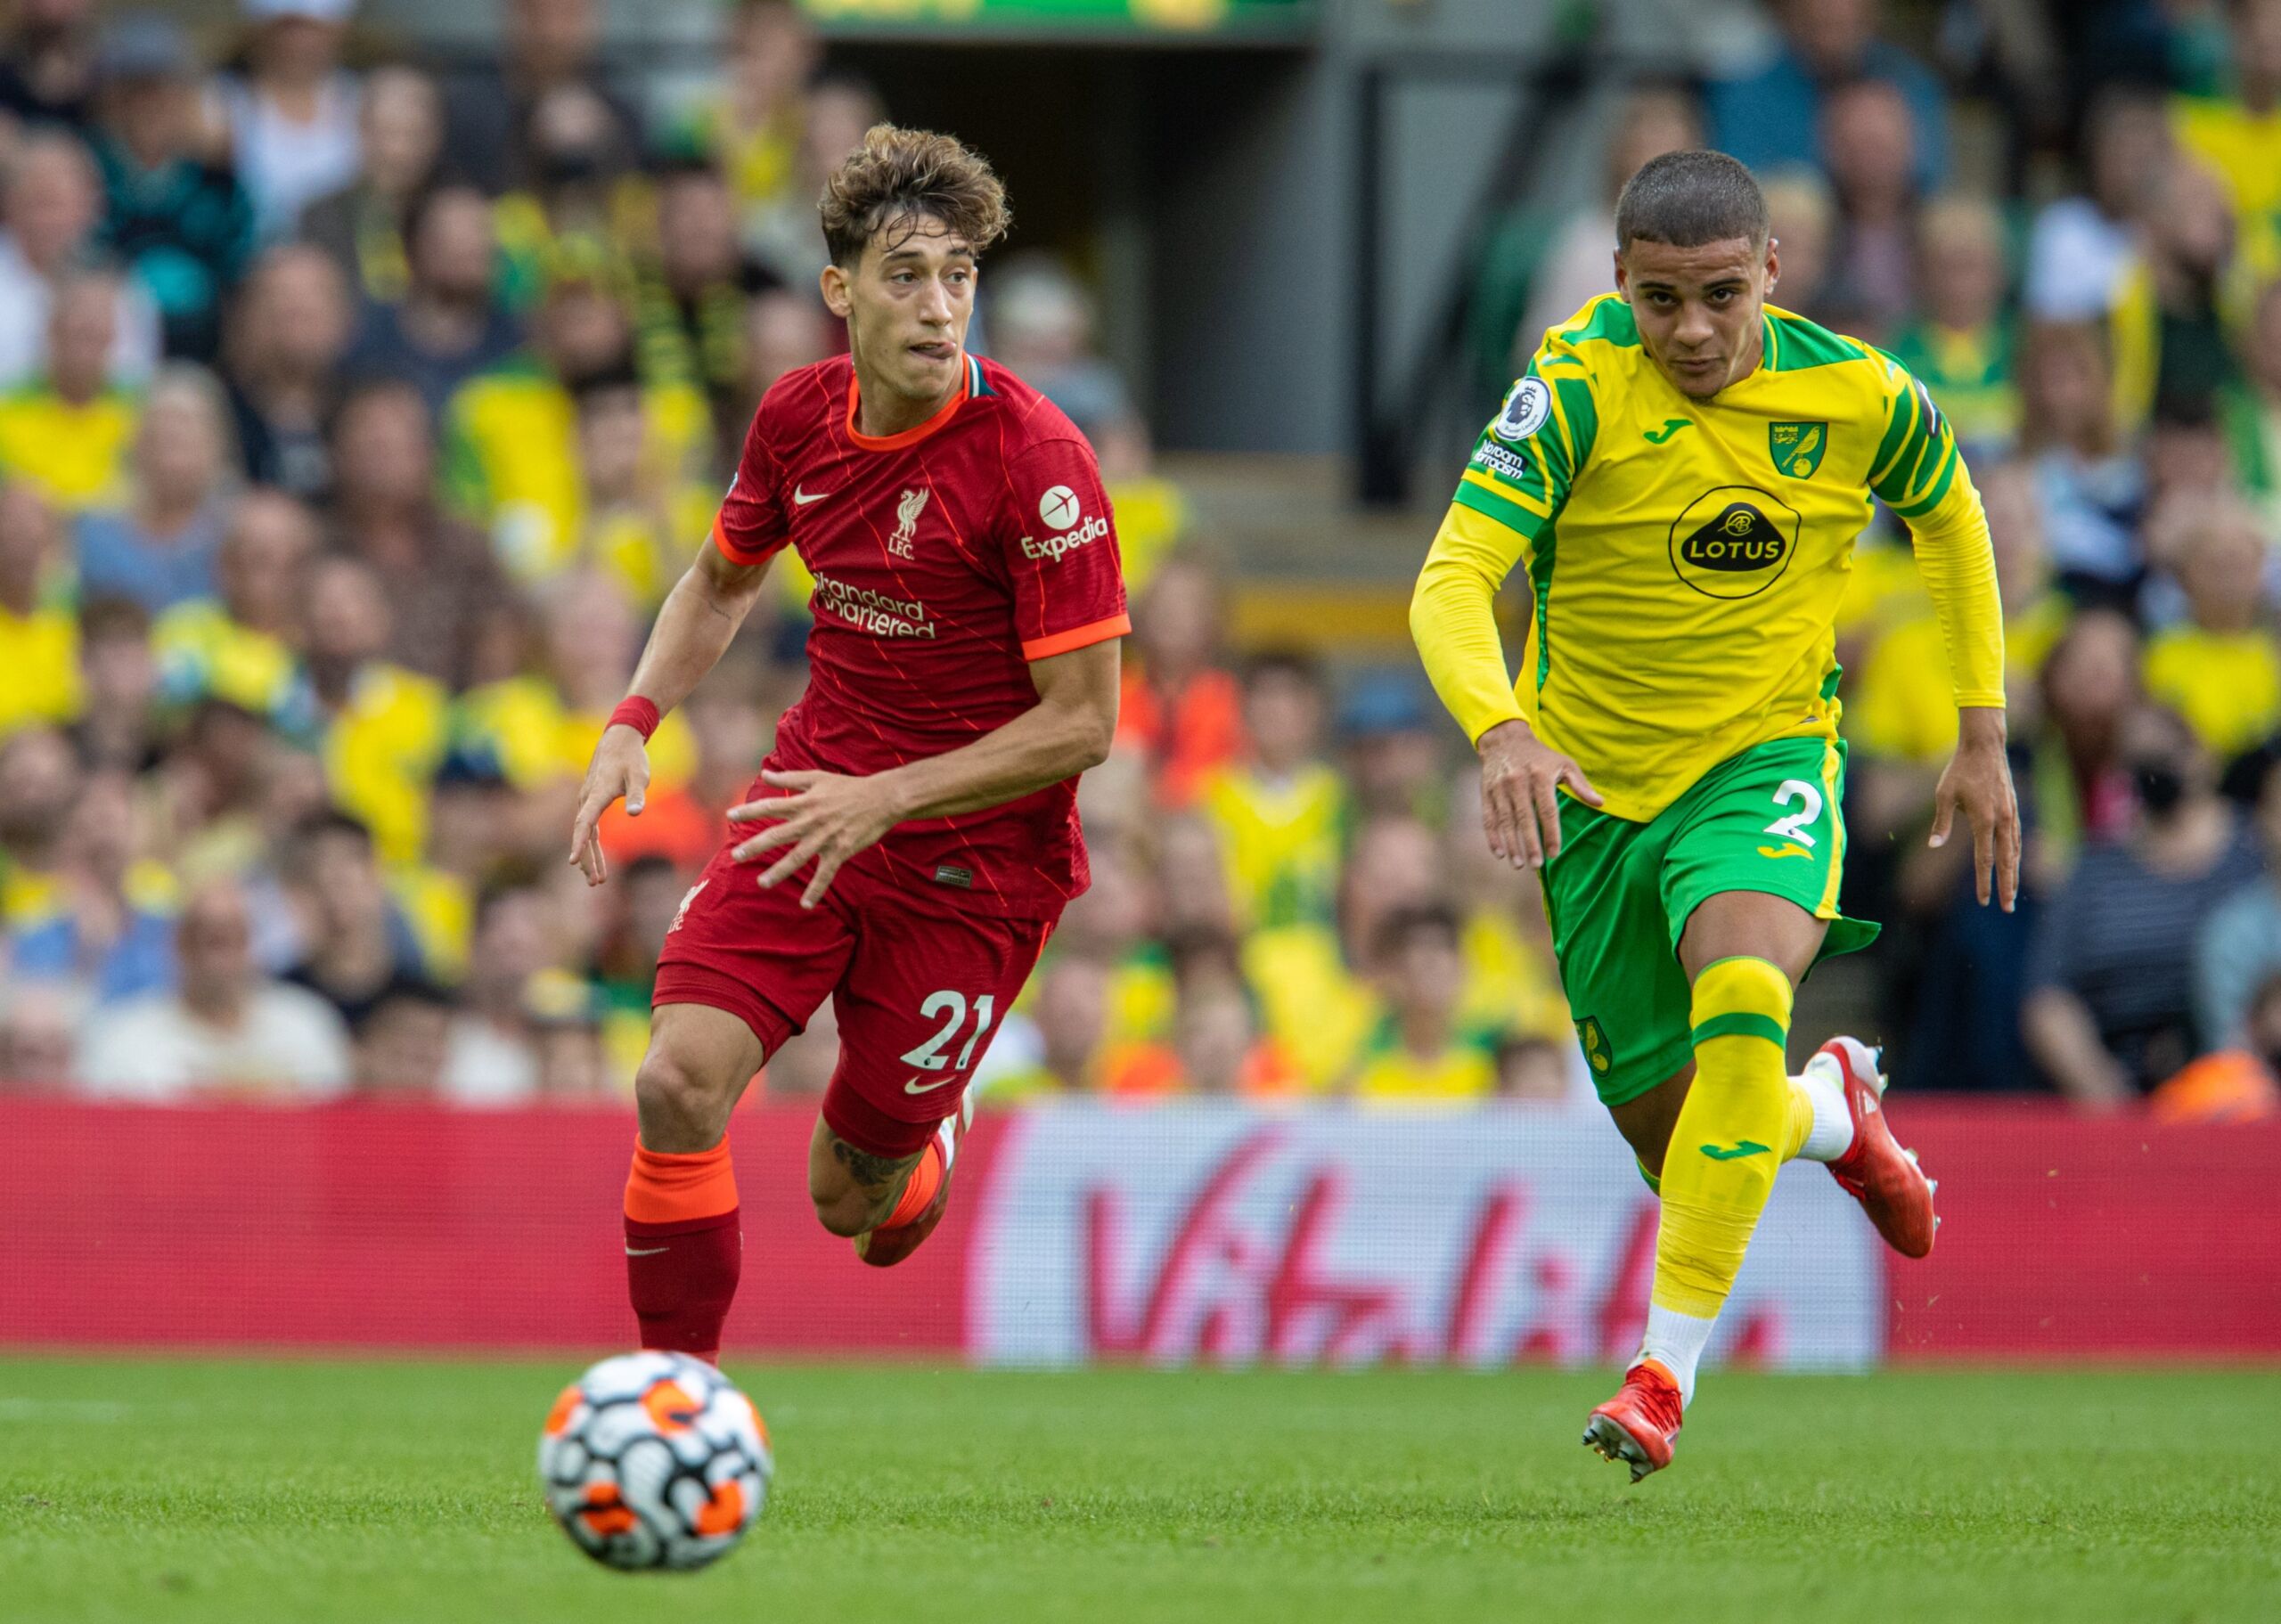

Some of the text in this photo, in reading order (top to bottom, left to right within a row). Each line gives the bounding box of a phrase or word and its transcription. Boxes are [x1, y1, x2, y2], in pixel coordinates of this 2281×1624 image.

[1484, 454, 1524, 479] racism
[1491, 446, 1523, 468] room
[1021, 516, 1108, 563] Expedia
[1690, 541, 1780, 559] LOTUS
[1763, 779, 1823, 847] 2
[899, 990, 995, 1071] 21
